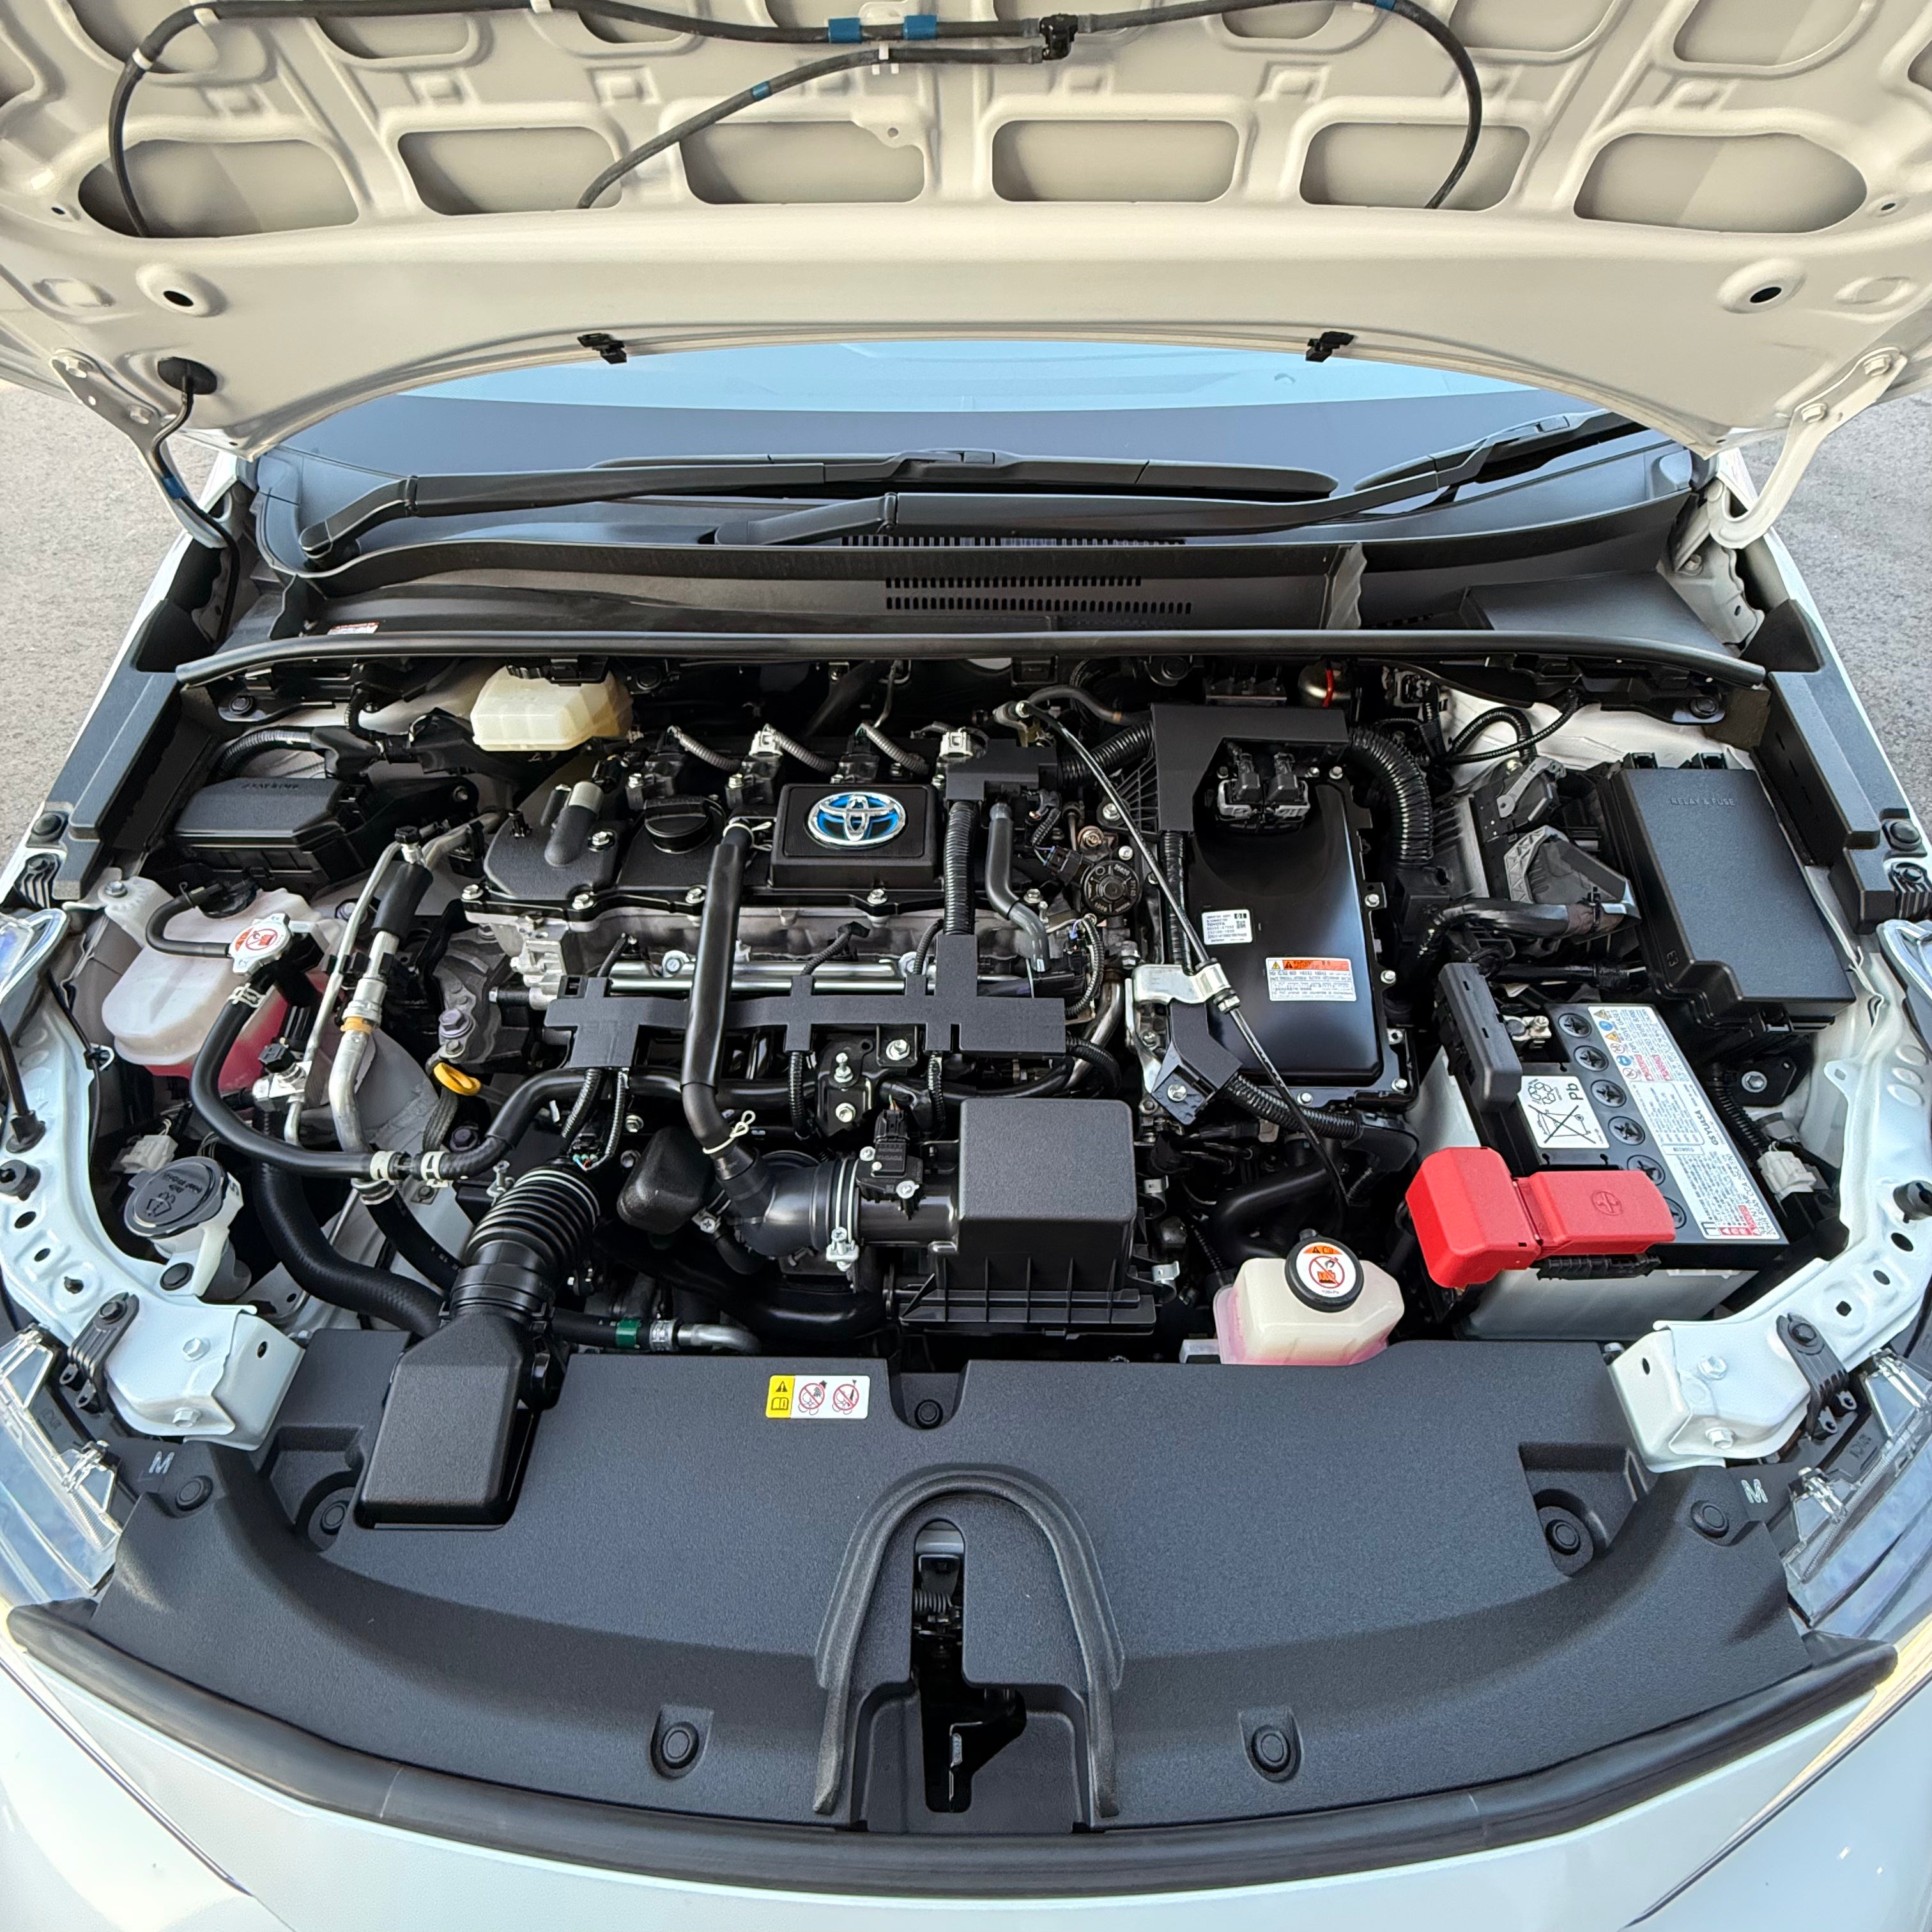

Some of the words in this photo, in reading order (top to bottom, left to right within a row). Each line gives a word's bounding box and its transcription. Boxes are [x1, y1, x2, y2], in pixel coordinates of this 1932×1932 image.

[1669, 797, 1699, 806] RELAY
[1711, 797, 1736, 806] FUSE
[1567, 1083, 1584, 1101] Pb
[1695, 1110, 1712, 1135] YUASA
[1708, 1136, 1719, 1145] GS
[149, 1451, 174, 1473] M
[1741, 1479, 1768, 1503] M
